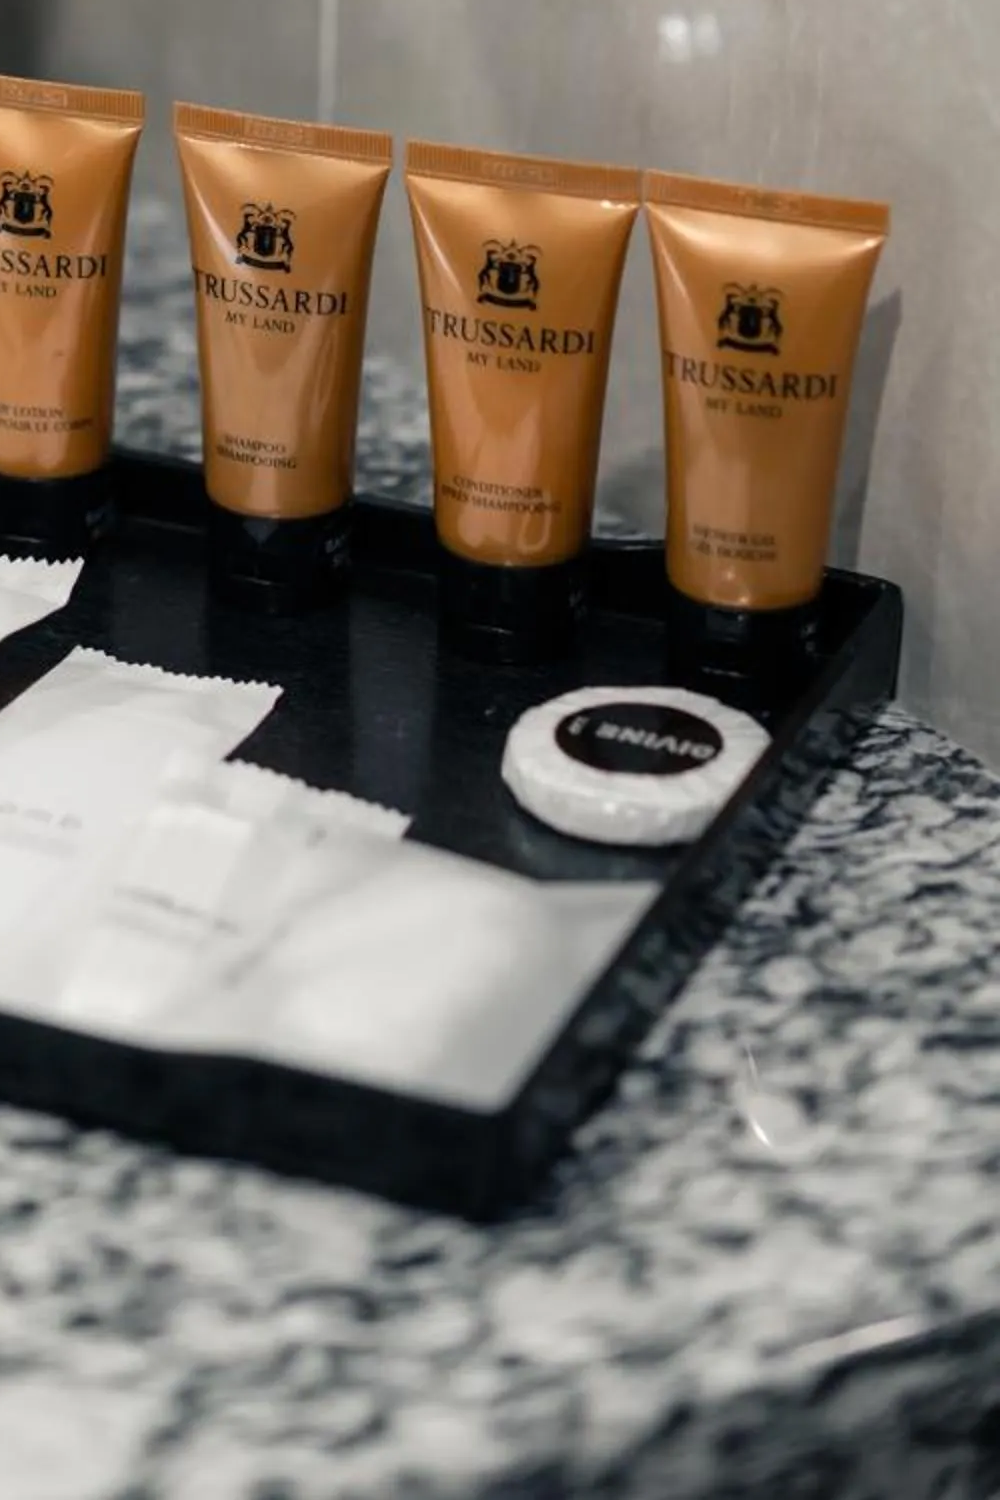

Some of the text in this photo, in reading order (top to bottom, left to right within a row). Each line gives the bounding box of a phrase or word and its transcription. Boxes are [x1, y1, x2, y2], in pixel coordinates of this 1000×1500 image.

[15, 282, 57, 298] LAND
[192, 265, 348, 316] TRUSSARDI
[225, 311, 296, 334] MY LAND
[426, 306, 595, 355] TRUSSARDI
[467, 352, 542, 373] MY LAND
[664, 350, 839, 401] TRUSSARDI
[594, 722, 716, 761] DIVINE
